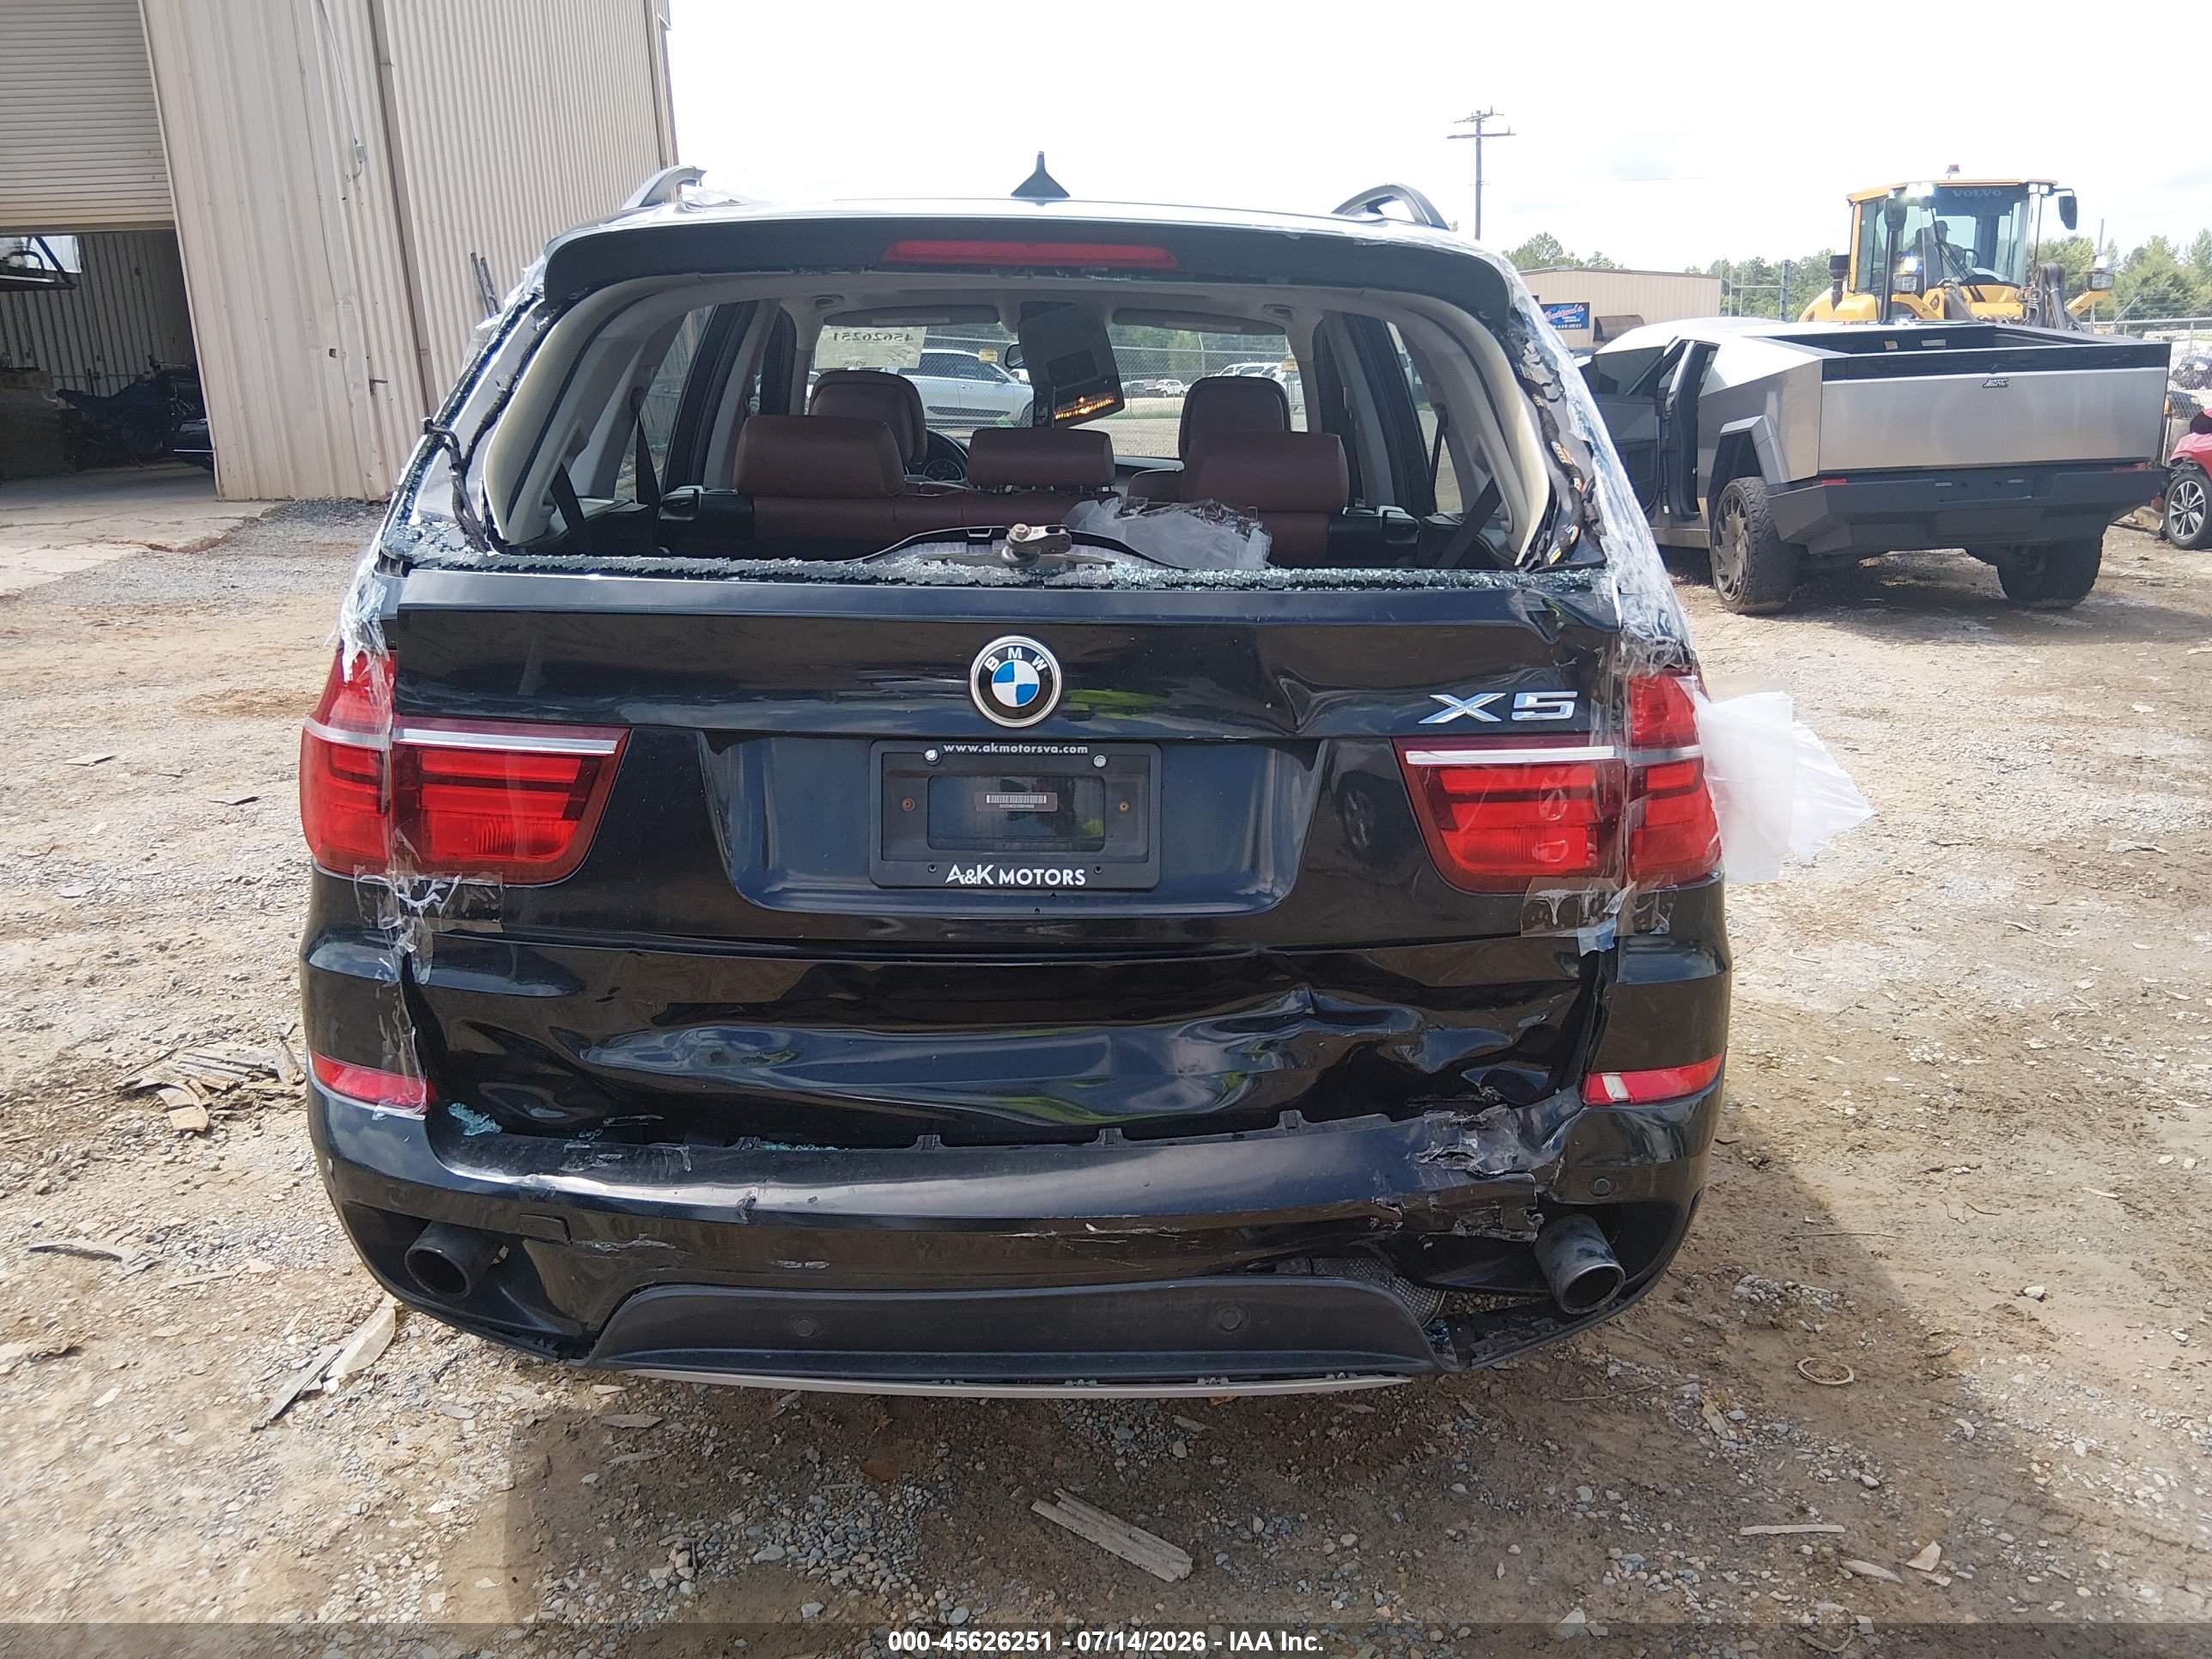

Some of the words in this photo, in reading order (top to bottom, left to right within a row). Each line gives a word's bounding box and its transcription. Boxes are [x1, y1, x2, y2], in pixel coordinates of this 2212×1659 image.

[1952, 189, 2002, 198] VOLVO
[984, 647, 1048, 672] BMW
[1418, 691, 1578, 724] X5
[944, 742, 1088, 754] www.akmotorsva.com
[945, 863, 995, 885] A&K
[999, 868, 1086, 886] MOTORS
